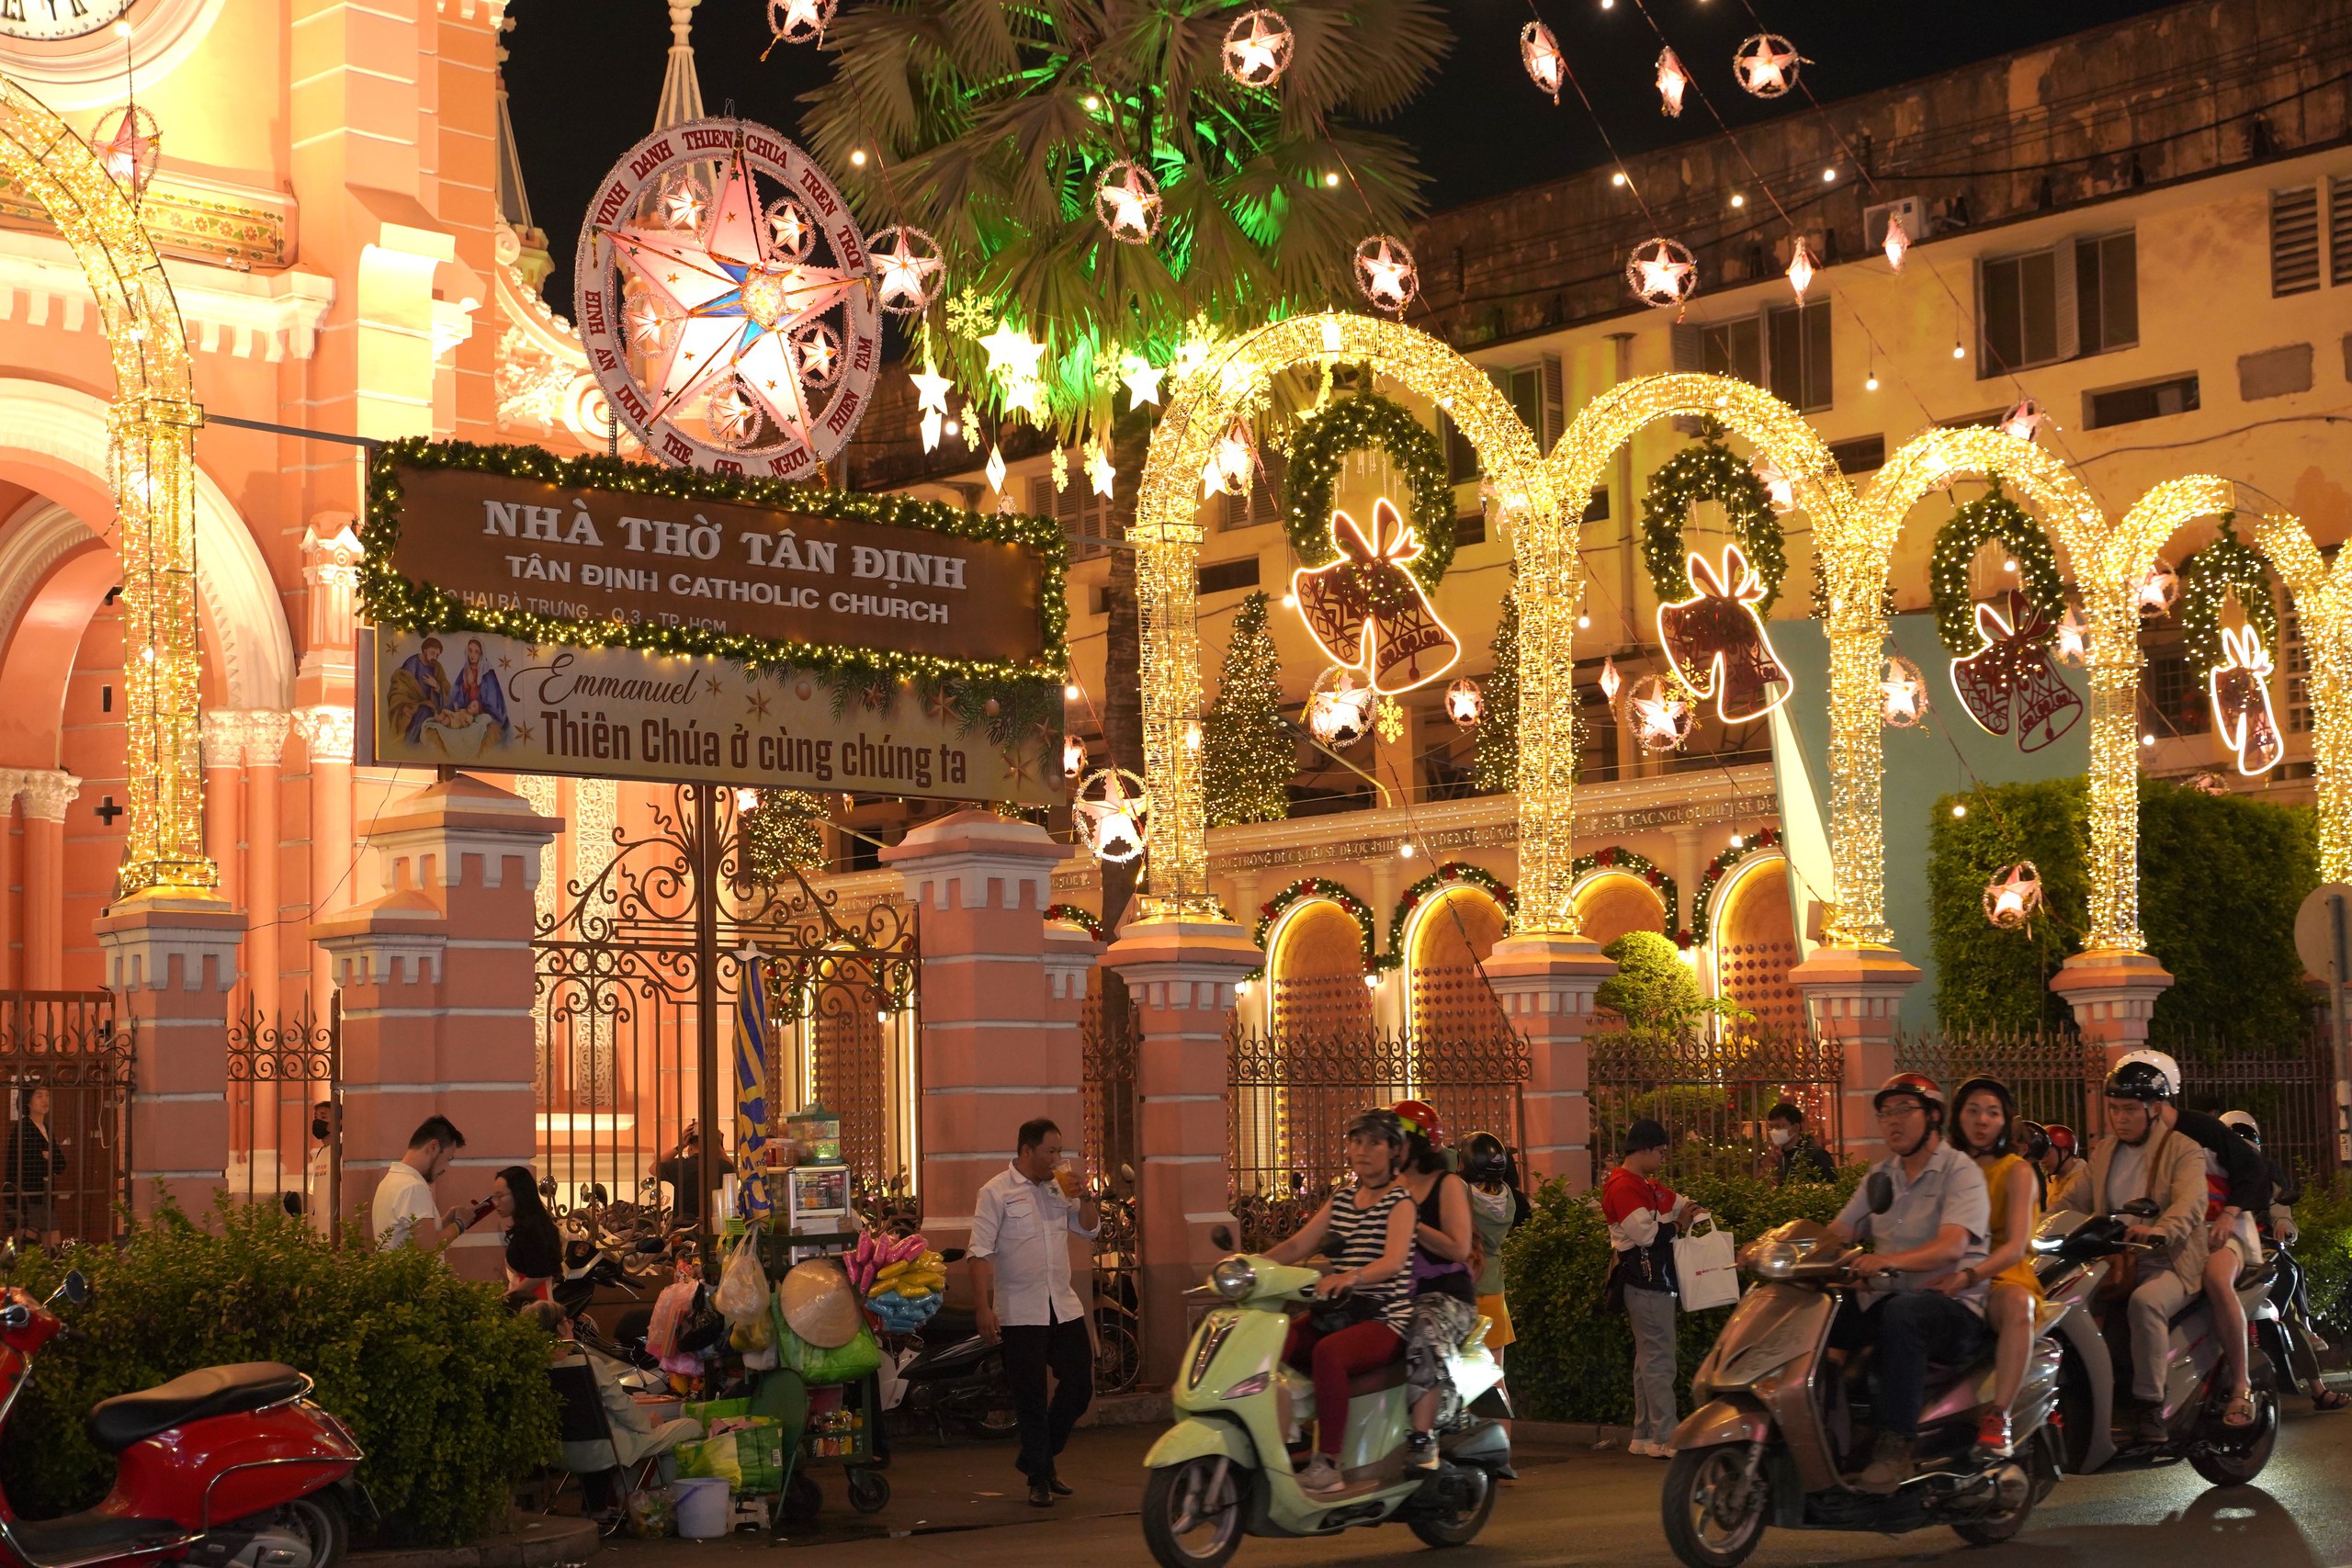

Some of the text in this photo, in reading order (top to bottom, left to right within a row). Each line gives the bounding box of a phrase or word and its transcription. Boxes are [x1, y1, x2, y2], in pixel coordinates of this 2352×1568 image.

[596, 130, 865, 270] VINH DANH THIEN CHUA TREN TROI
[584, 290, 606, 335] BINH
[595, 347, 618, 372] AN
[615, 384, 649, 425] DUOI
[662, 432, 694, 466] THE
[767, 446, 811, 477] NGUOI
[826, 391, 860, 436] THIEN
[854, 335, 874, 373] TAM
[482, 497, 967, 590] NHÀ THỜ TÂN ĐỊNH
[463, 590, 493, 608] HAI
[498, 591, 522, 611] BÀ
[527, 596, 589, 619] TRƯNG
[611, 607, 640, 625] Q.3
[505, 552, 949, 625] TÂN ĐỊNH CATHOLIC CHURCH
[508, 653, 700, 705] Emmanuel
[540, 709, 967, 788] Thiên Chúa ở cùng chúng ta
